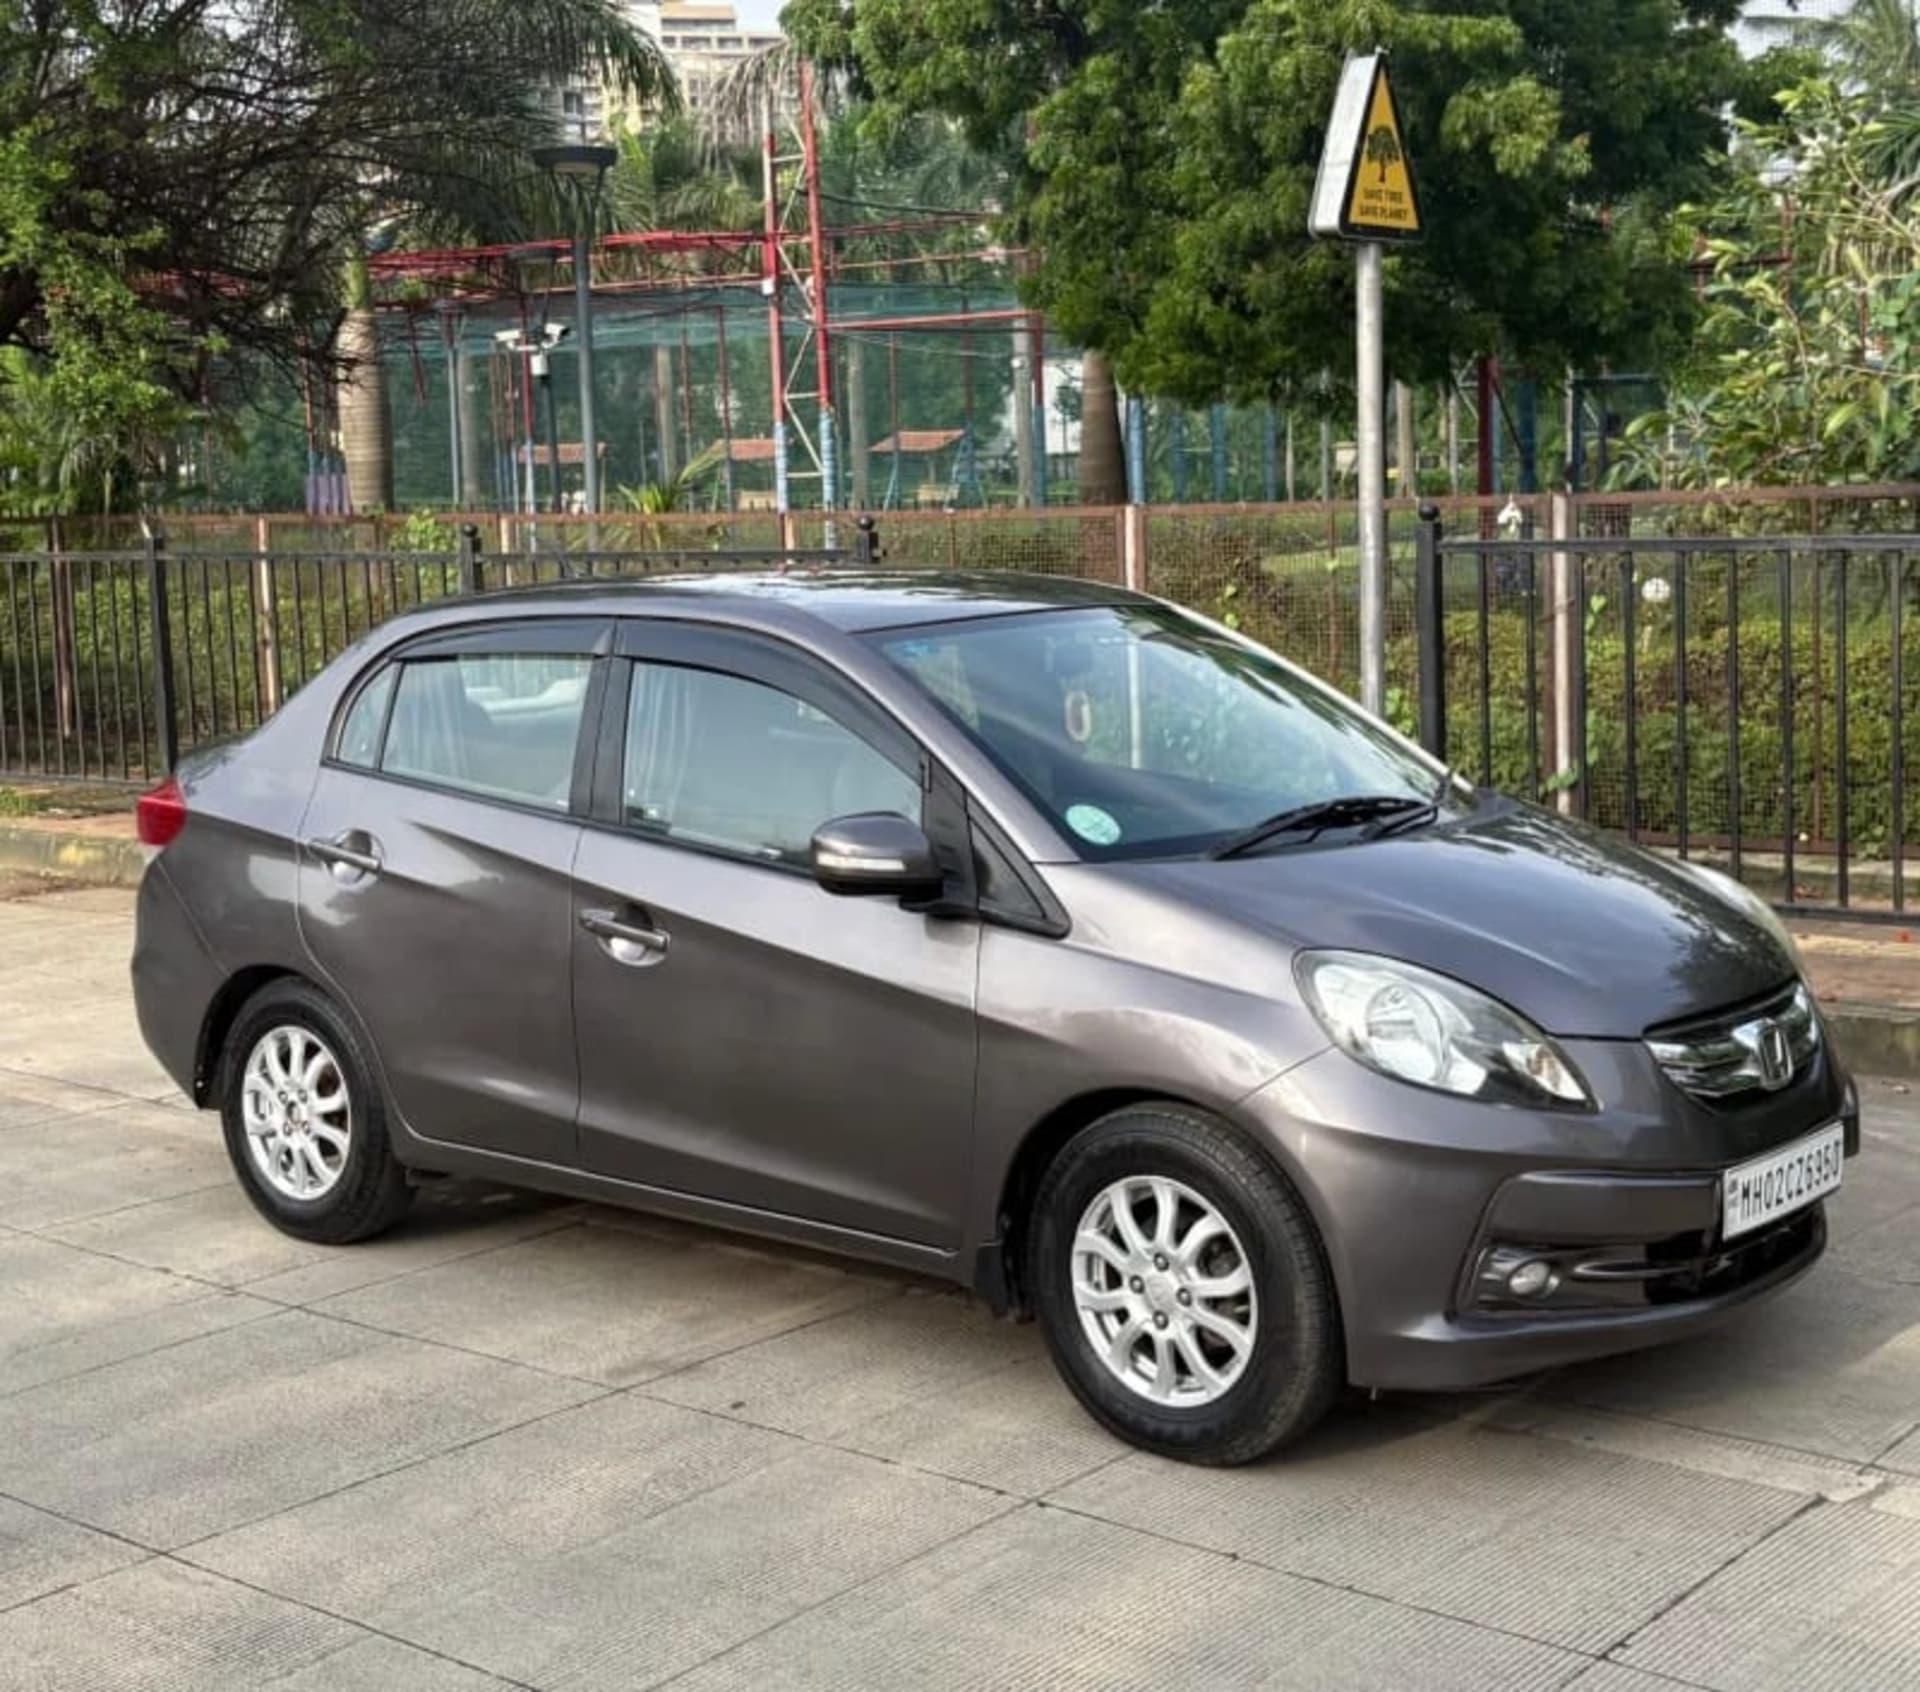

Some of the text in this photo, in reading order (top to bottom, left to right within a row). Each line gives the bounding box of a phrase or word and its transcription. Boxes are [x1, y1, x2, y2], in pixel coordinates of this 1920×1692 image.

[1364, 188, 1383, 200] SAVE
[1359, 204, 1409, 222] SAVE PLANET
